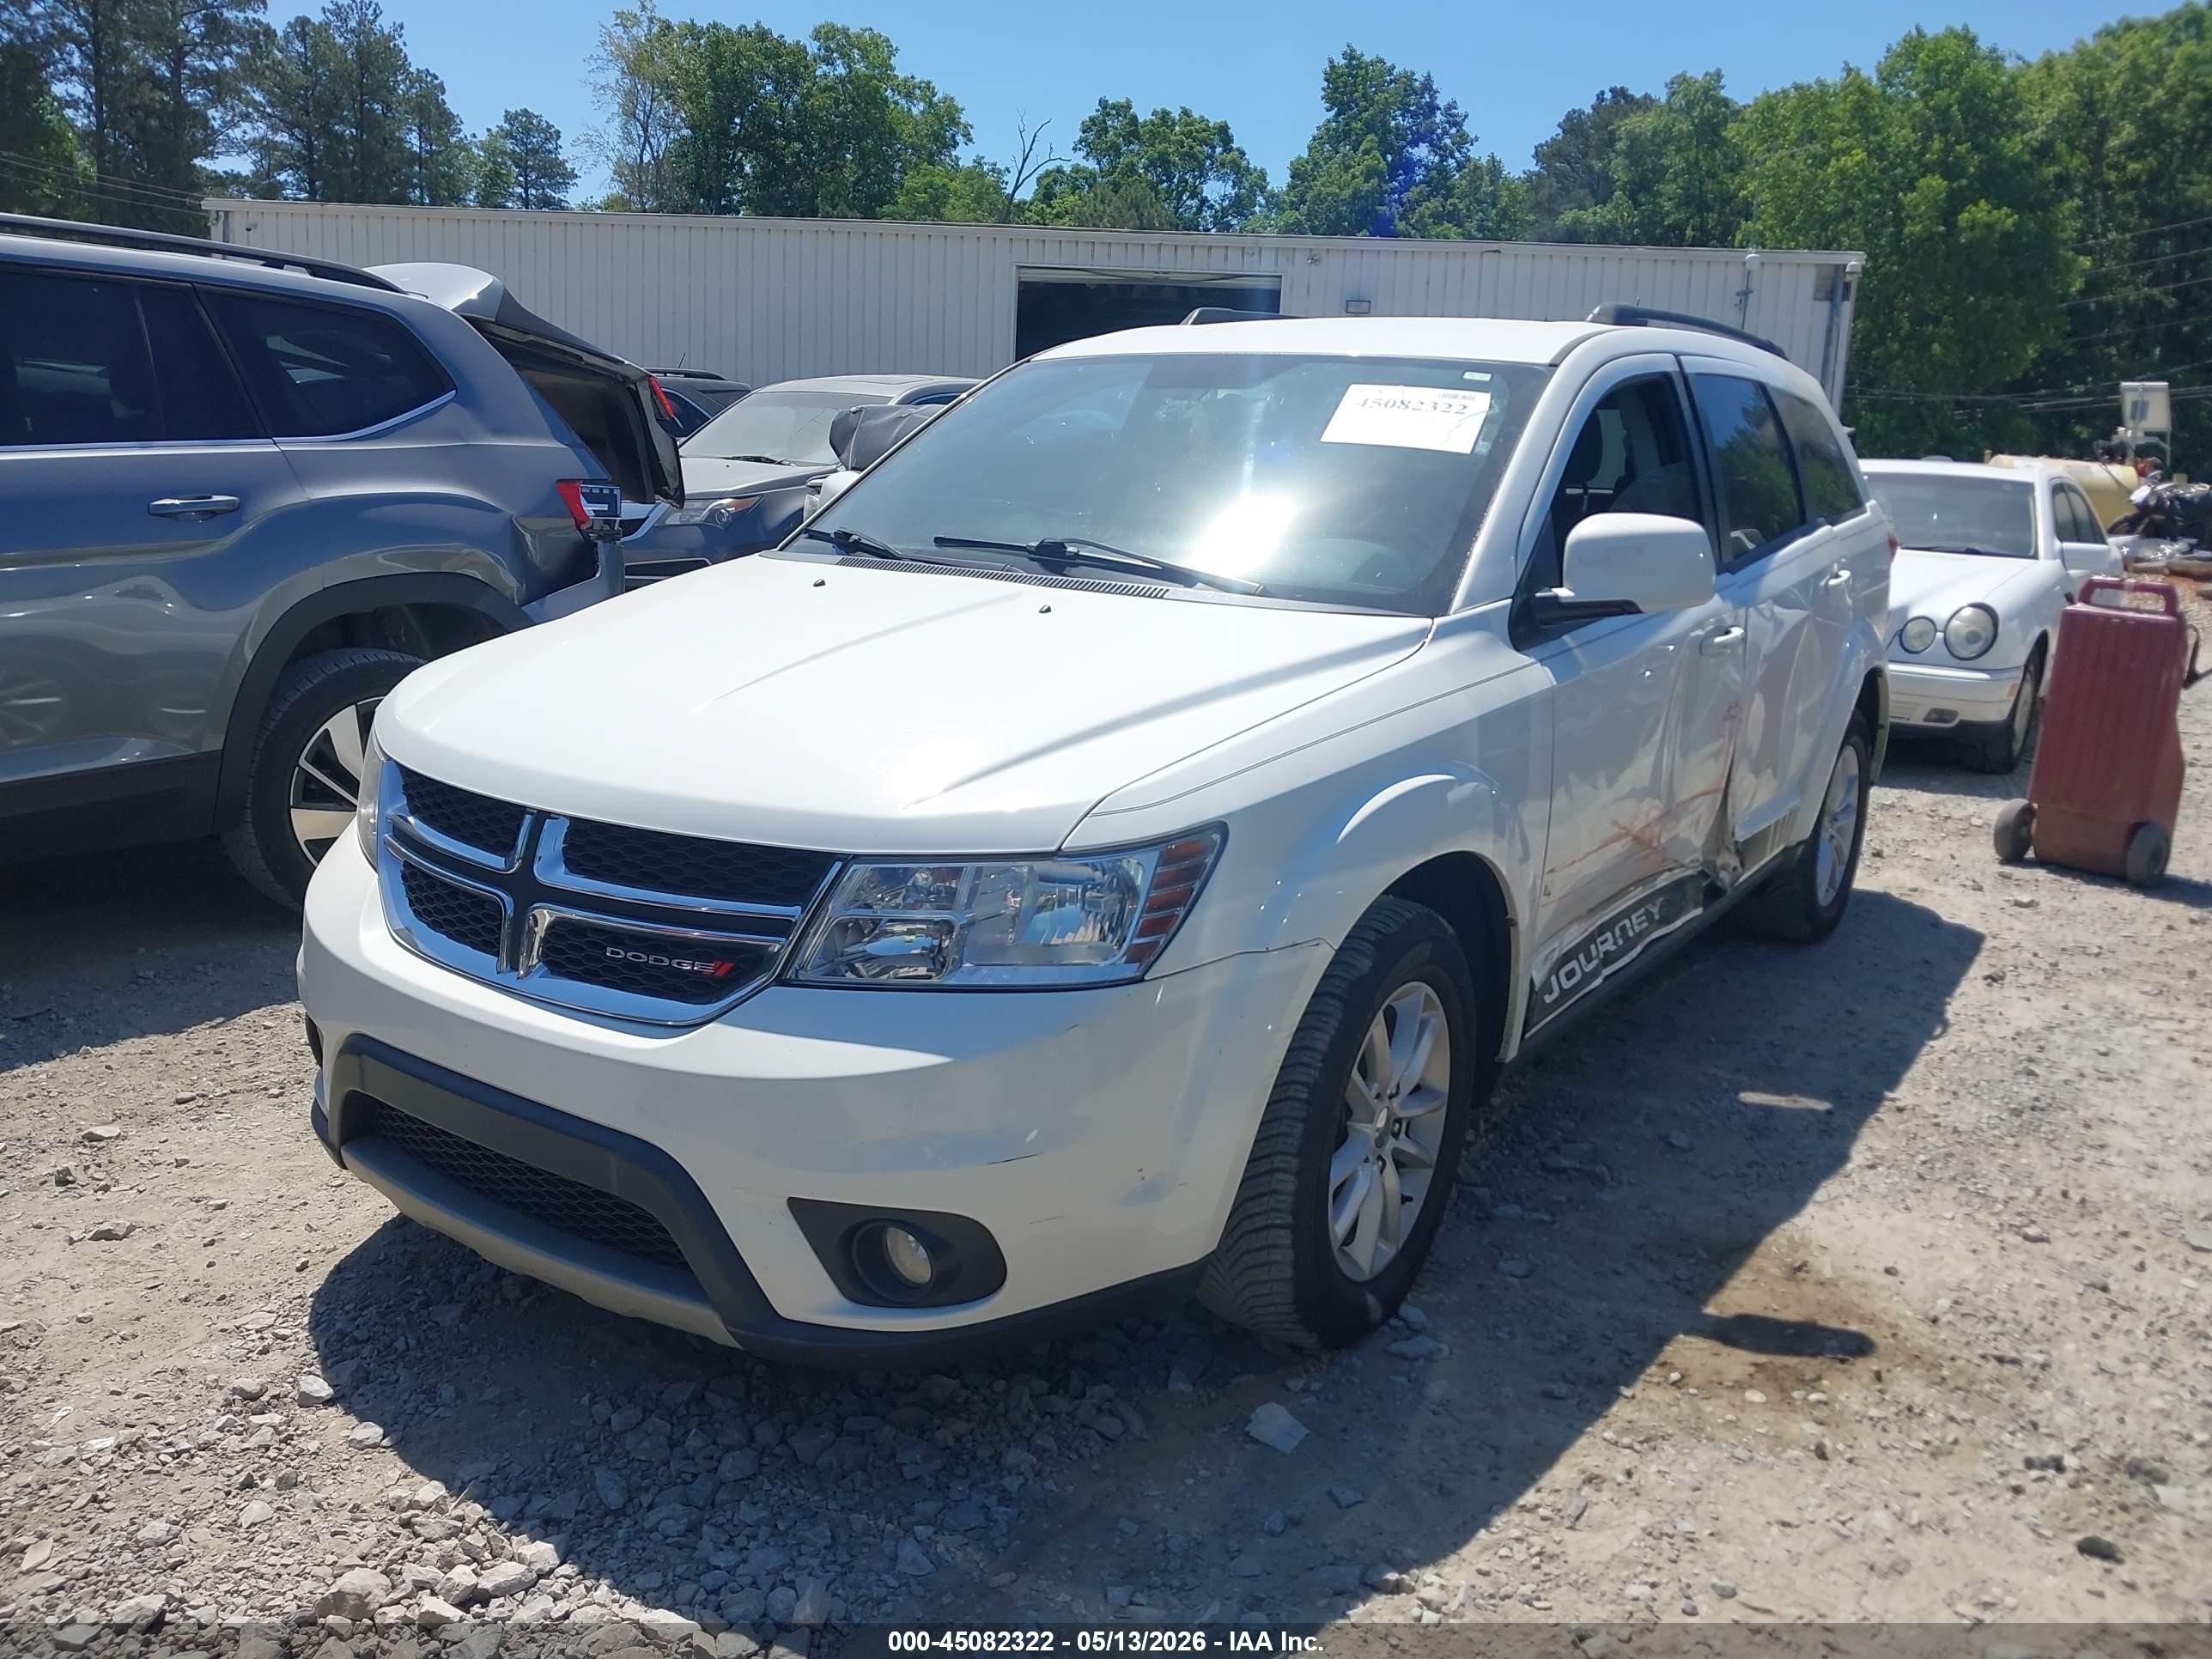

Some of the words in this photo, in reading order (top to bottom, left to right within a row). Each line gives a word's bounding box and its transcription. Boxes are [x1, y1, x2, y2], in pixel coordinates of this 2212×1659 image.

[1355, 398, 1468, 415] 45082322
[605, 946, 715, 973] DODGE
[1544, 896, 1665, 1004] JOURNEY
